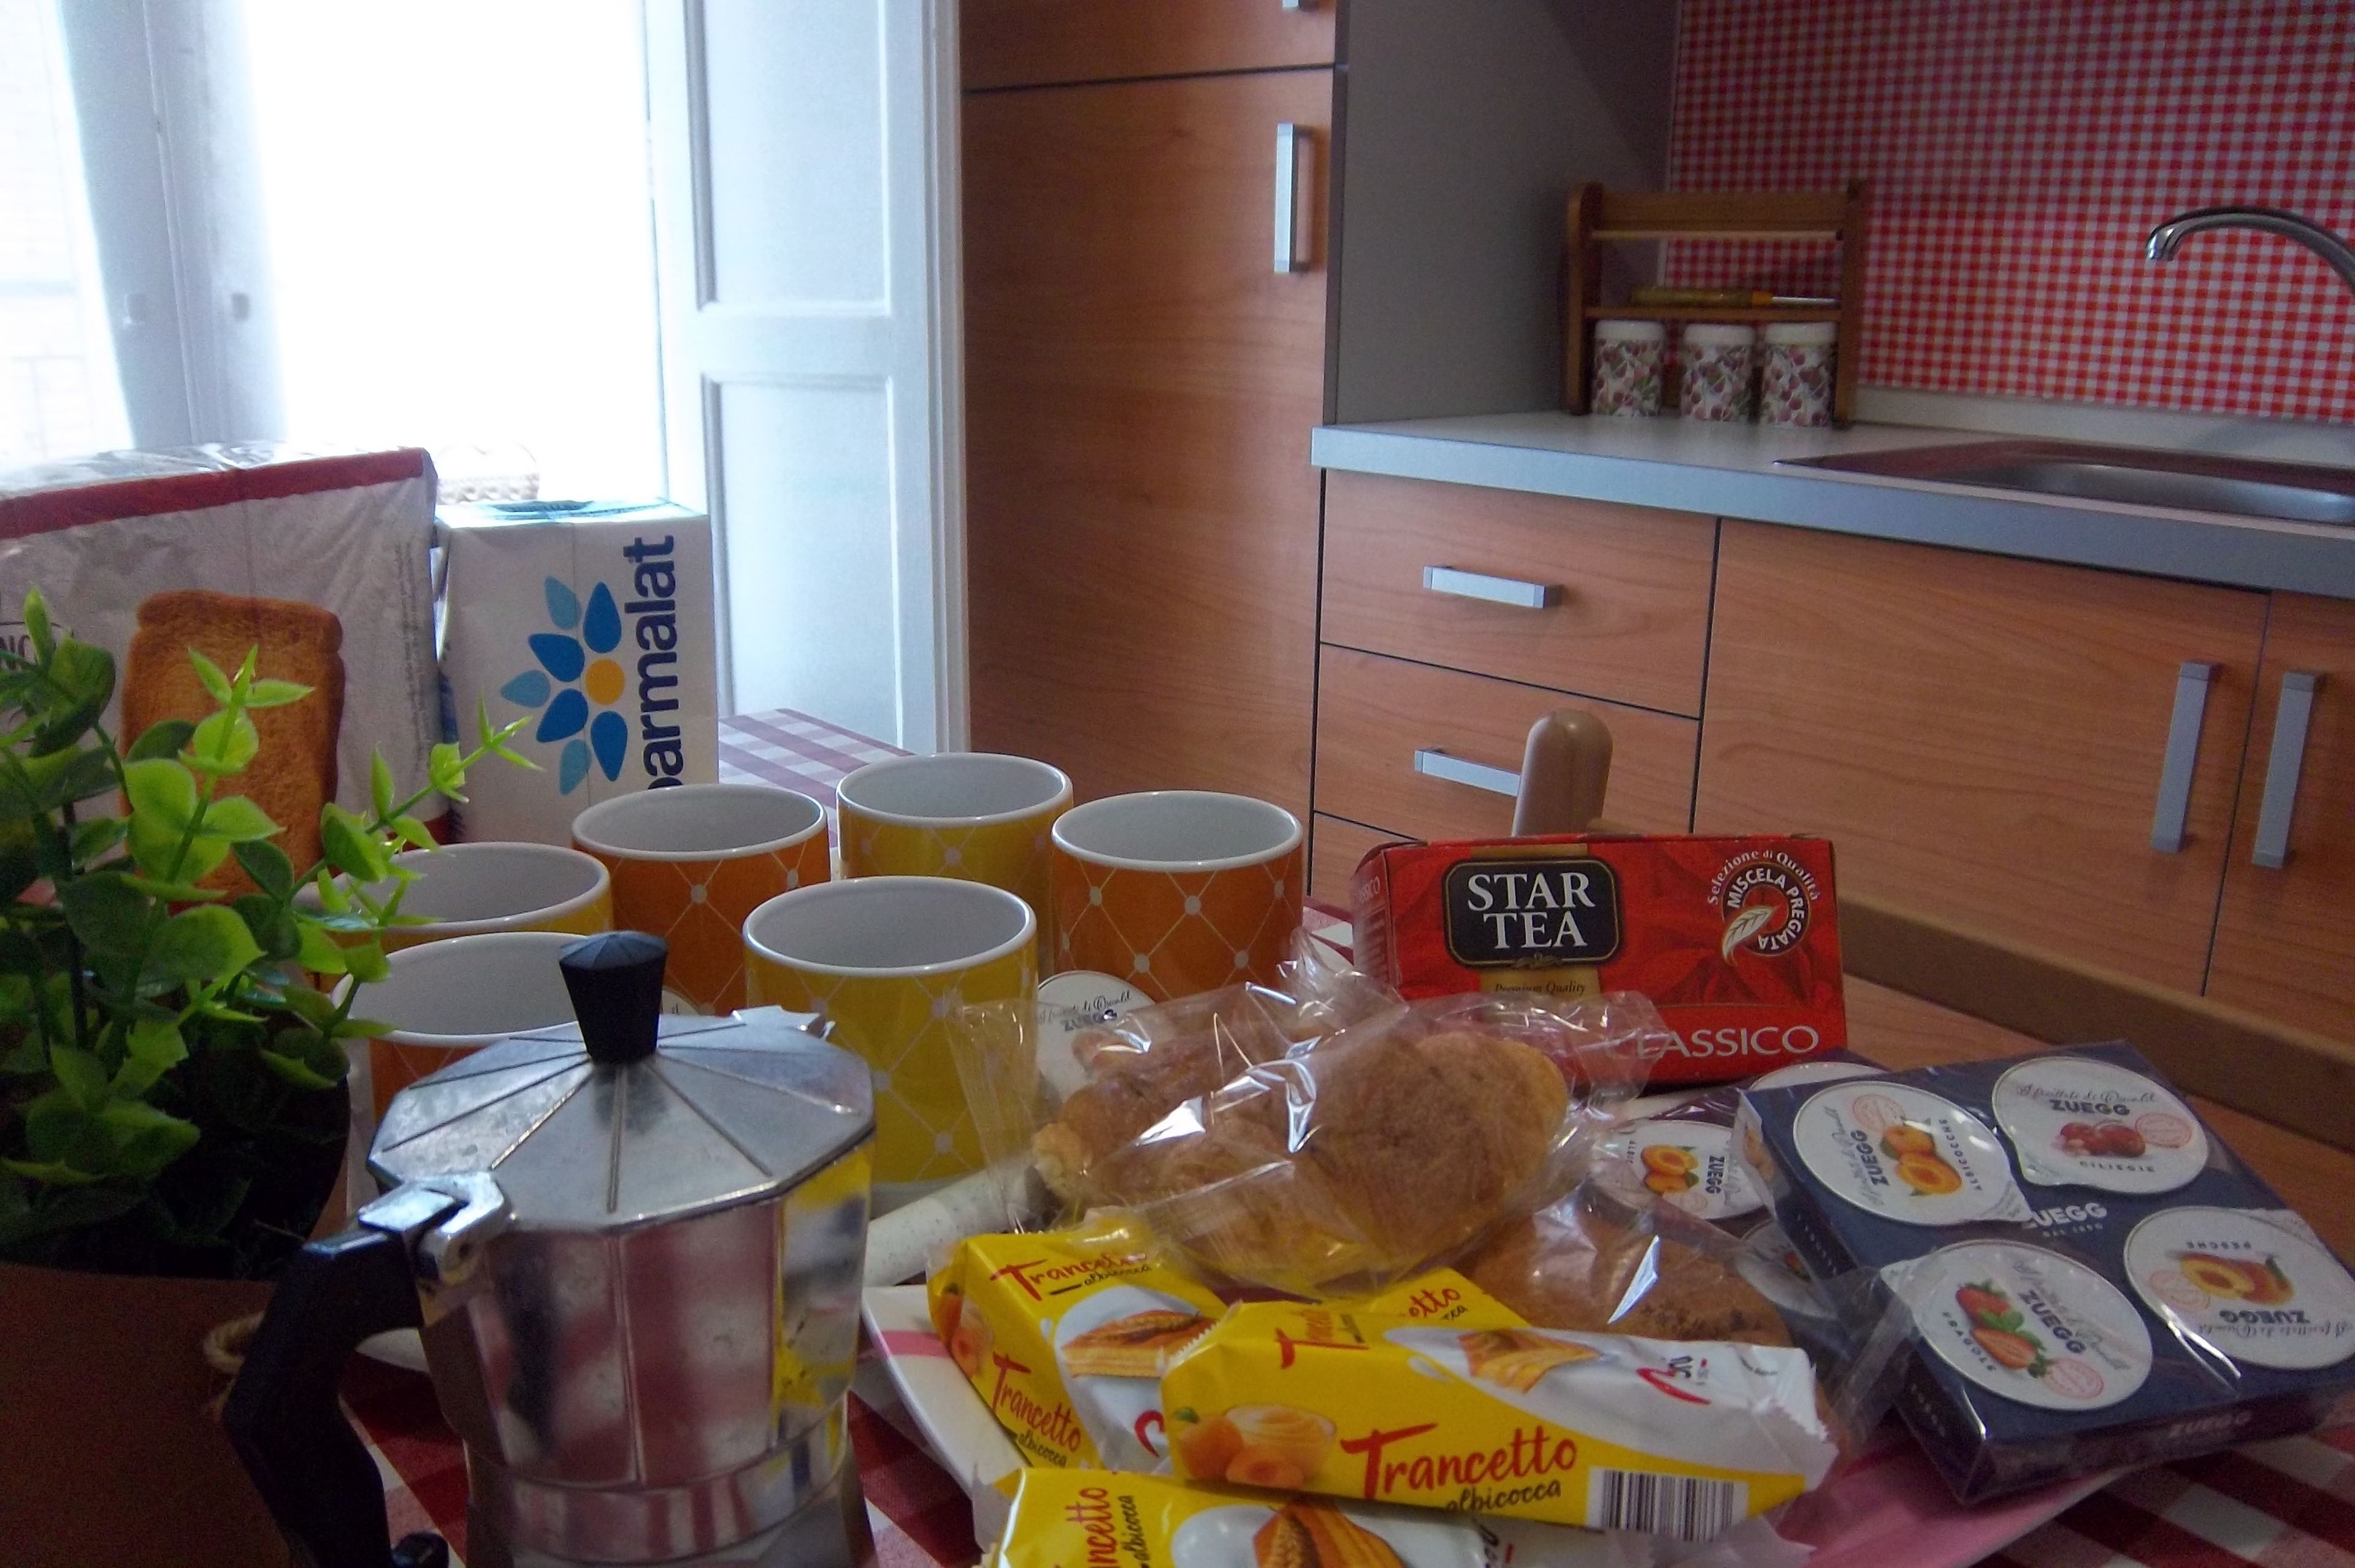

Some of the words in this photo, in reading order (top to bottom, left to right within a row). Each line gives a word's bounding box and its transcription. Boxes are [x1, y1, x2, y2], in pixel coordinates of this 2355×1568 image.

[1467, 872, 1596, 911] STAR
[1707, 851, 1759, 904] Selezione
[1777, 852, 1820, 901] Qualità
[1727, 868, 1786, 909] MISCELA
[1758, 885, 1805, 950] PREGIATA
[1483, 910, 1588, 949] TEA
[1546, 980, 1586, 996] Quality
[2049, 1099, 2131, 1116] ZUEGG
[1705, 1155, 1726, 1195] ZUEGG
[1850, 1130, 1890, 1187] ZUEGG
[2021, 1202, 2108, 1229] UEGG
[1408, 1288, 1460, 1318] etto
[2018, 1290, 2087, 1355] ZUEGG
[2218, 1310, 2311, 1325] ZUEGG
[991, 1352, 1082, 1453] Trancetto
[1340, 1423, 1577, 1500] Trancetto
[1446, 1480, 1561, 1511] albicocca
[1064, 1487, 1122, 1568] ncetto
[1117, 1494, 1151, 1562] albicocca
